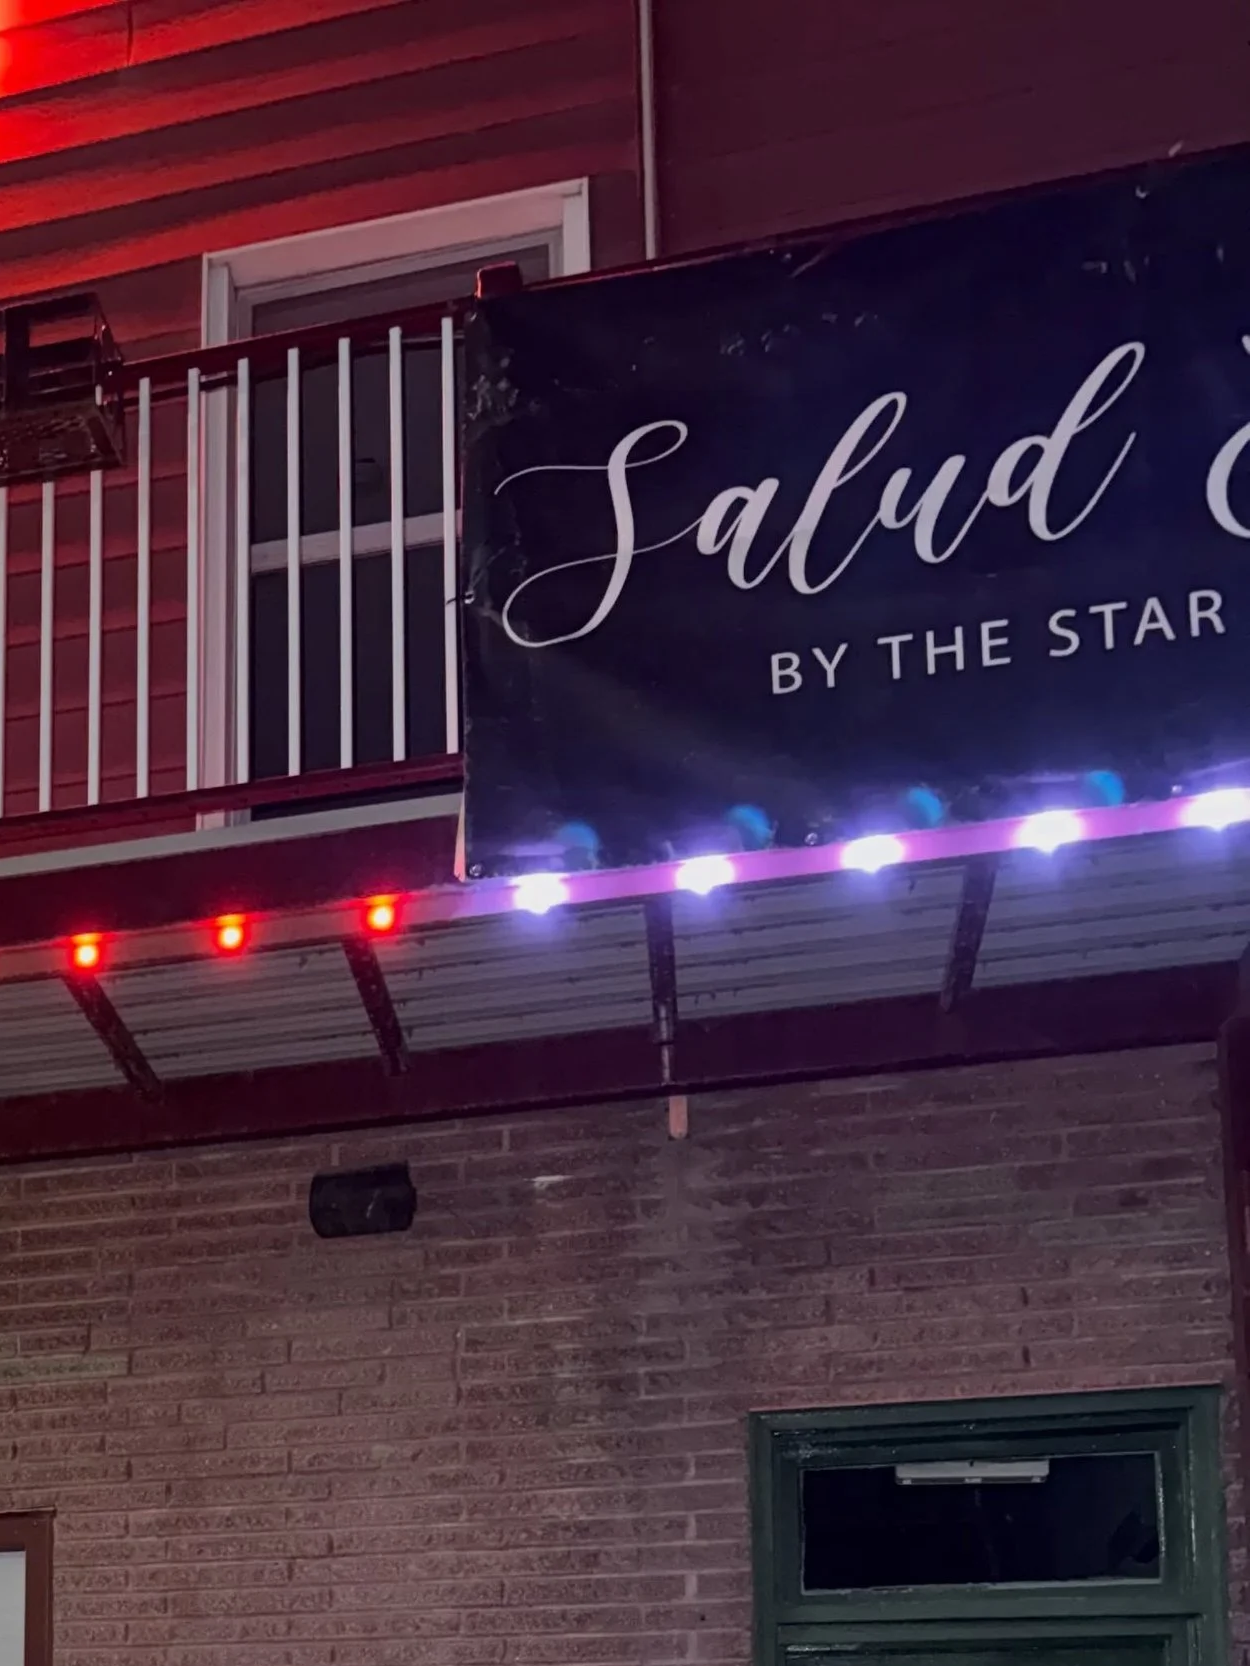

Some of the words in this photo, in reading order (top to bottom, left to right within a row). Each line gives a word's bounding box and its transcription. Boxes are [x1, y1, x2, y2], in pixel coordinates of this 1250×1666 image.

[494, 341, 1146, 648] Salud
[770, 641, 848, 695] BY
[877, 619, 1013, 680] THE
[1049, 588, 1226, 658] STAR
